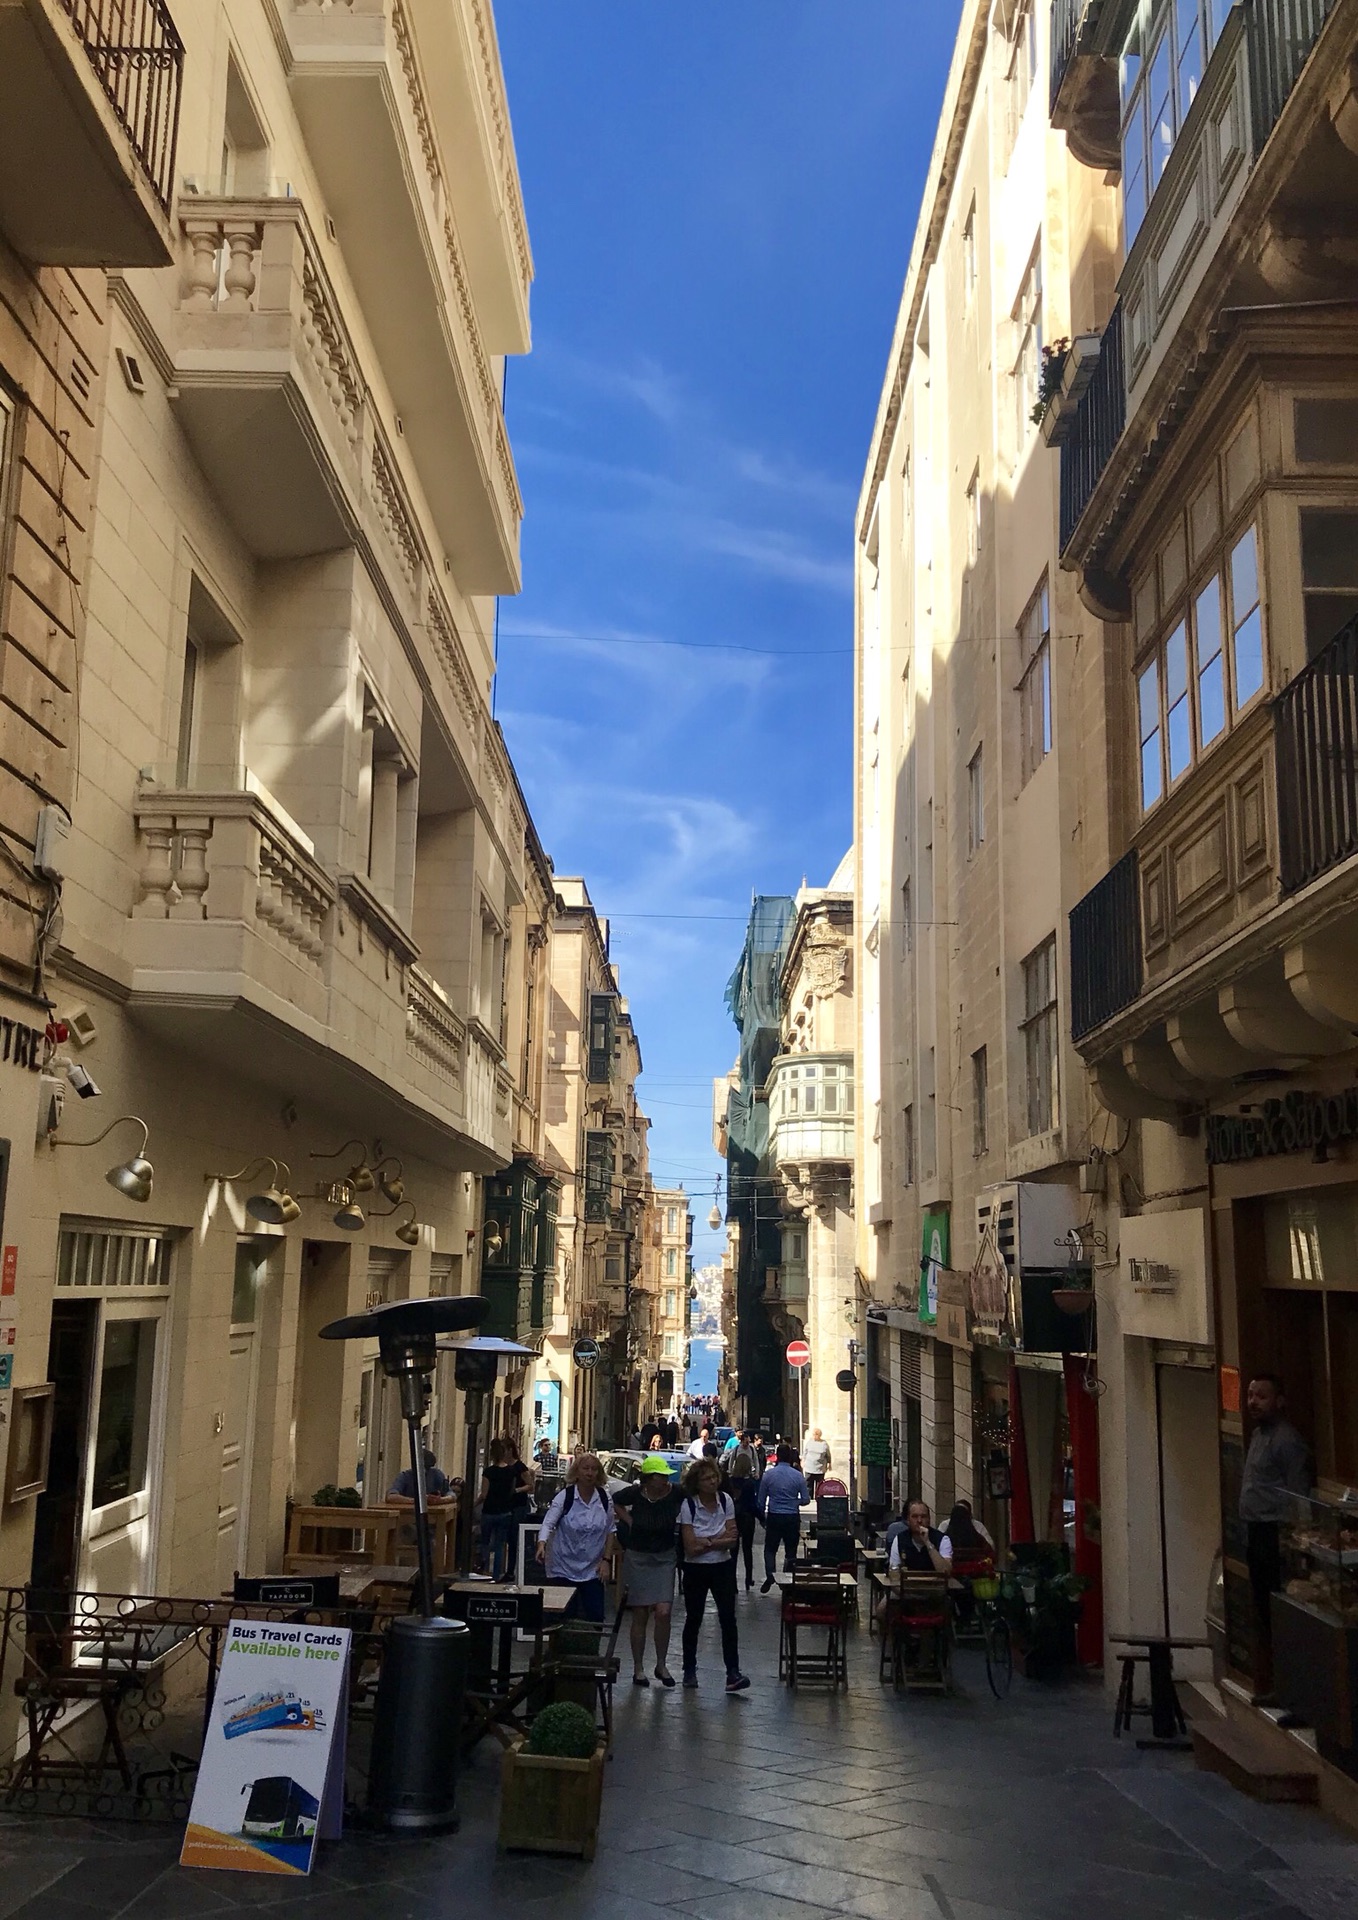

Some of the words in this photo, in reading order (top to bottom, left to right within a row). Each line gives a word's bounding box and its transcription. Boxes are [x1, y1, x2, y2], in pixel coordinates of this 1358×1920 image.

[0, 1015, 45, 1073] TRE
[232, 1627, 256, 1639] Bus
[260, 1629, 301, 1642] Travel
[304, 1633, 342, 1646] Cards
[229, 1640, 301, 1658] Available
[305, 1646, 340, 1661] here
